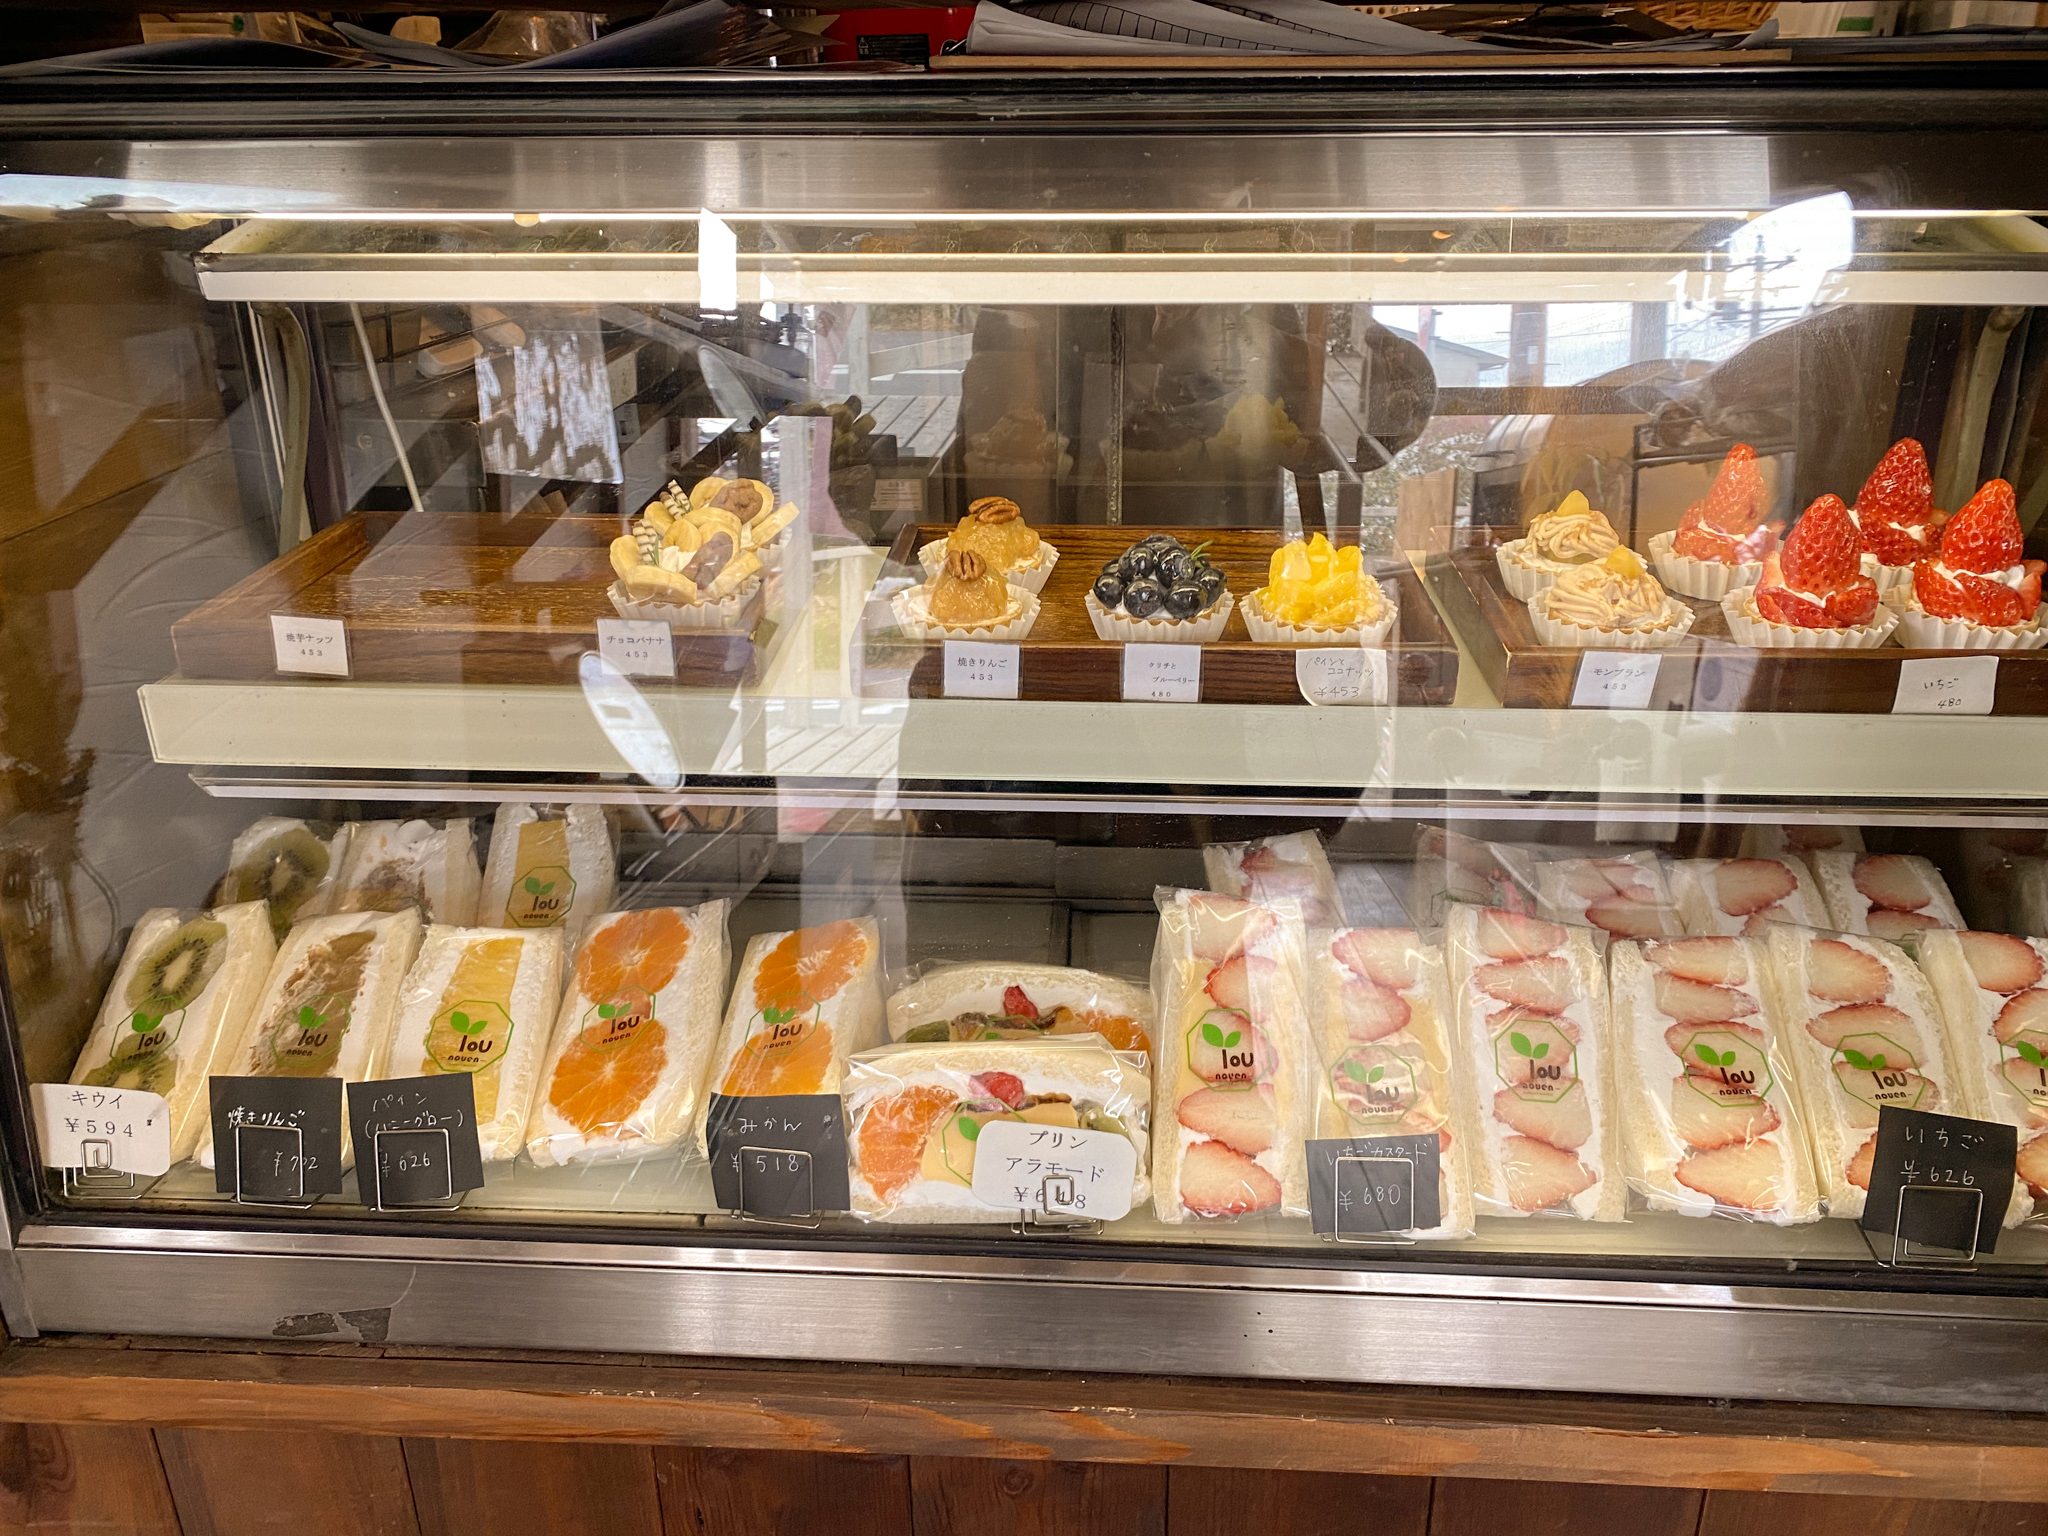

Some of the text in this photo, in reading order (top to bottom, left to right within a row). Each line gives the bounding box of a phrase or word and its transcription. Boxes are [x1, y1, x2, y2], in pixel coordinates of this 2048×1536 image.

[606, 635, 665, 645] チョコバナナ
[300, 648, 323, 657] 453
[957, 656, 1008, 669] 焼きりんご
[970, 673, 993, 681] 453
[1327, 666, 1375, 678] ココナッツ
[1593, 668, 1646, 677] モンブラン
[1313, 686, 1360, 699] ¥453
[1923, 677, 1959, 690] いちご
[1937, 697, 1962, 709] 480
[71, 1090, 123, 1109] キウイ
[372, 1093, 427, 1112] パイン
[228, 1105, 306, 1129] 焼きりんご
[738, 1117, 802, 1134] みかん
[64, 1118, 134, 1138] ¥594
[1029, 1130, 1089, 1149] プリン
[1905, 1126, 1985, 1150] いちご
[730, 1153, 799, 1173] ¥518
[1006, 1156, 1105, 1183] アラモード
[1900, 1159, 1975, 1186] ¥626
[1338, 1183, 1401, 1212] ¥680
